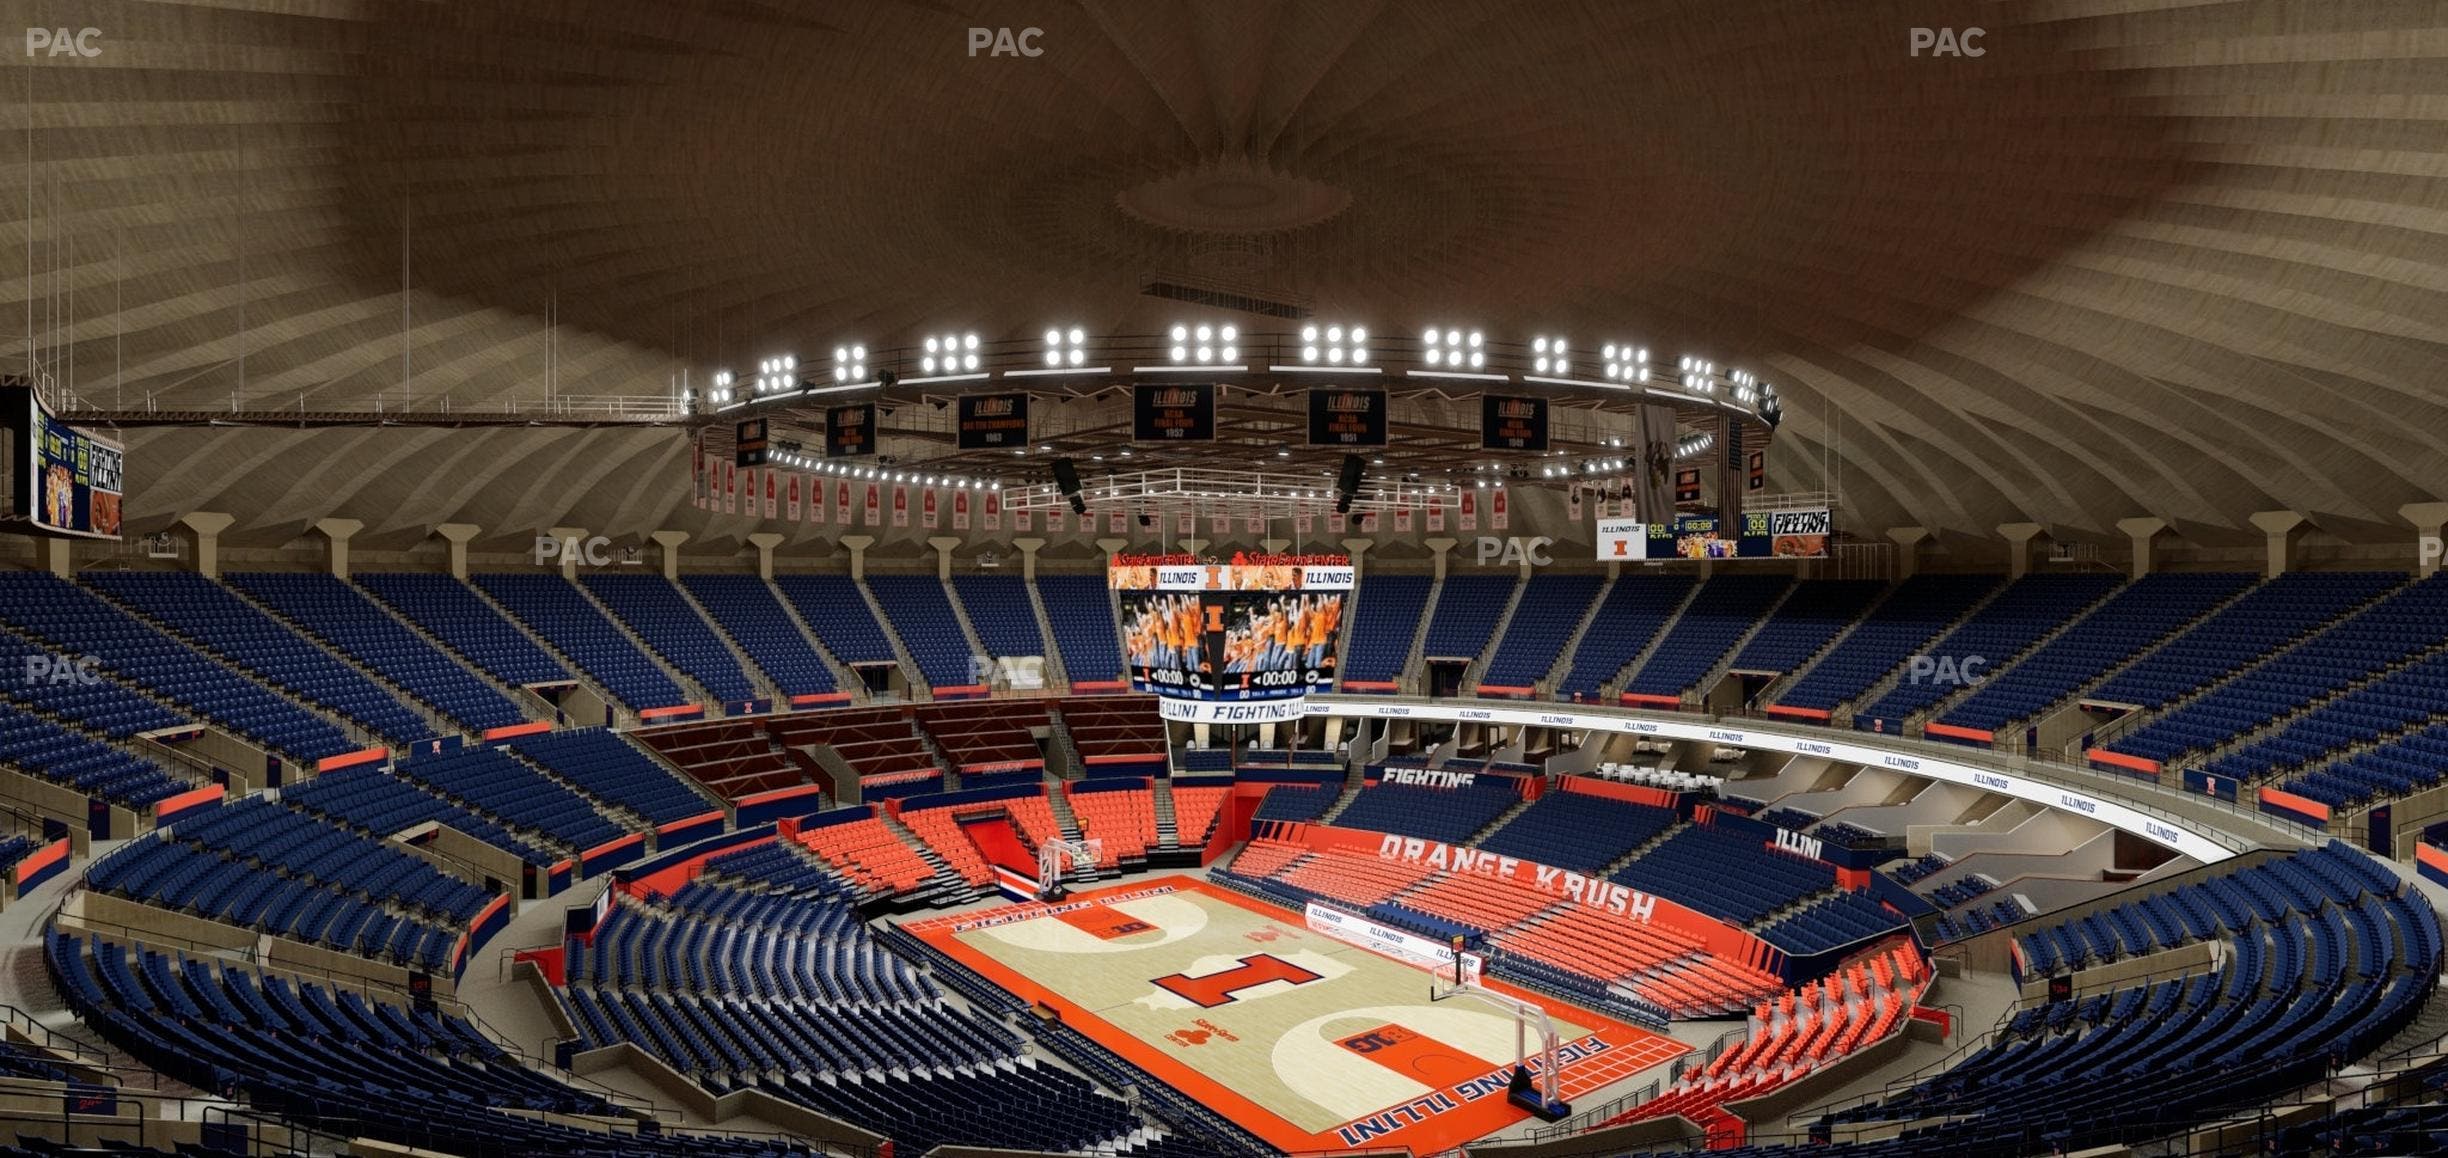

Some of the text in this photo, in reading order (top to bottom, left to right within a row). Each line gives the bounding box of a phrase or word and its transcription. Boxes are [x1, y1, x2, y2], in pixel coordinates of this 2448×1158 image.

[1153, 391, 1197, 404] ILLINOIS
[1328, 396, 1370, 409] ILLINOIS
[975, 399, 1013, 413] ILLINOIS
[1499, 401, 1535, 415] ILLINOIS
[1774, 512, 1828, 525] FIGHTING
[1601, 525, 1640, 534] ILLINOIS
[1159, 572, 1197, 584] ILLINOIS
[1306, 572, 1352, 584] ILLINOIS
[1157, 669, 1184, 685] 00:00
[1262, 670, 1297, 686] 00:00
[1213, 704, 1286, 720] FIGHTING
[1459, 711, 1491, 719] ILLINOIS
[1541, 716, 1573, 725] ILLINOIS
[1624, 722, 1657, 732] ILLINOIS
[1709, 731, 1743, 742] ILLINOIS
[1796, 741, 1831, 755] ILLINOIS
[1884, 756, 1919, 770] ILLINOIS
[1383, 768, 1475, 788] FIGHTING
[1974, 773, 2008, 789] ILLINOIS
[2061, 794, 2095, 814] ILLINOIS
[2146, 821, 2178, 843] ILLINOIS
[1775, 828, 1822, 860] ILLINI
[1379, 835, 1520, 879] ORANGE
[1534, 864, 1656, 925] KRUSH
[1310, 908, 1342, 923] ILLINOIS
[1369, 927, 1404, 944] ILLINOIS
[1338, 1092, 1459, 1147] ILLINI
